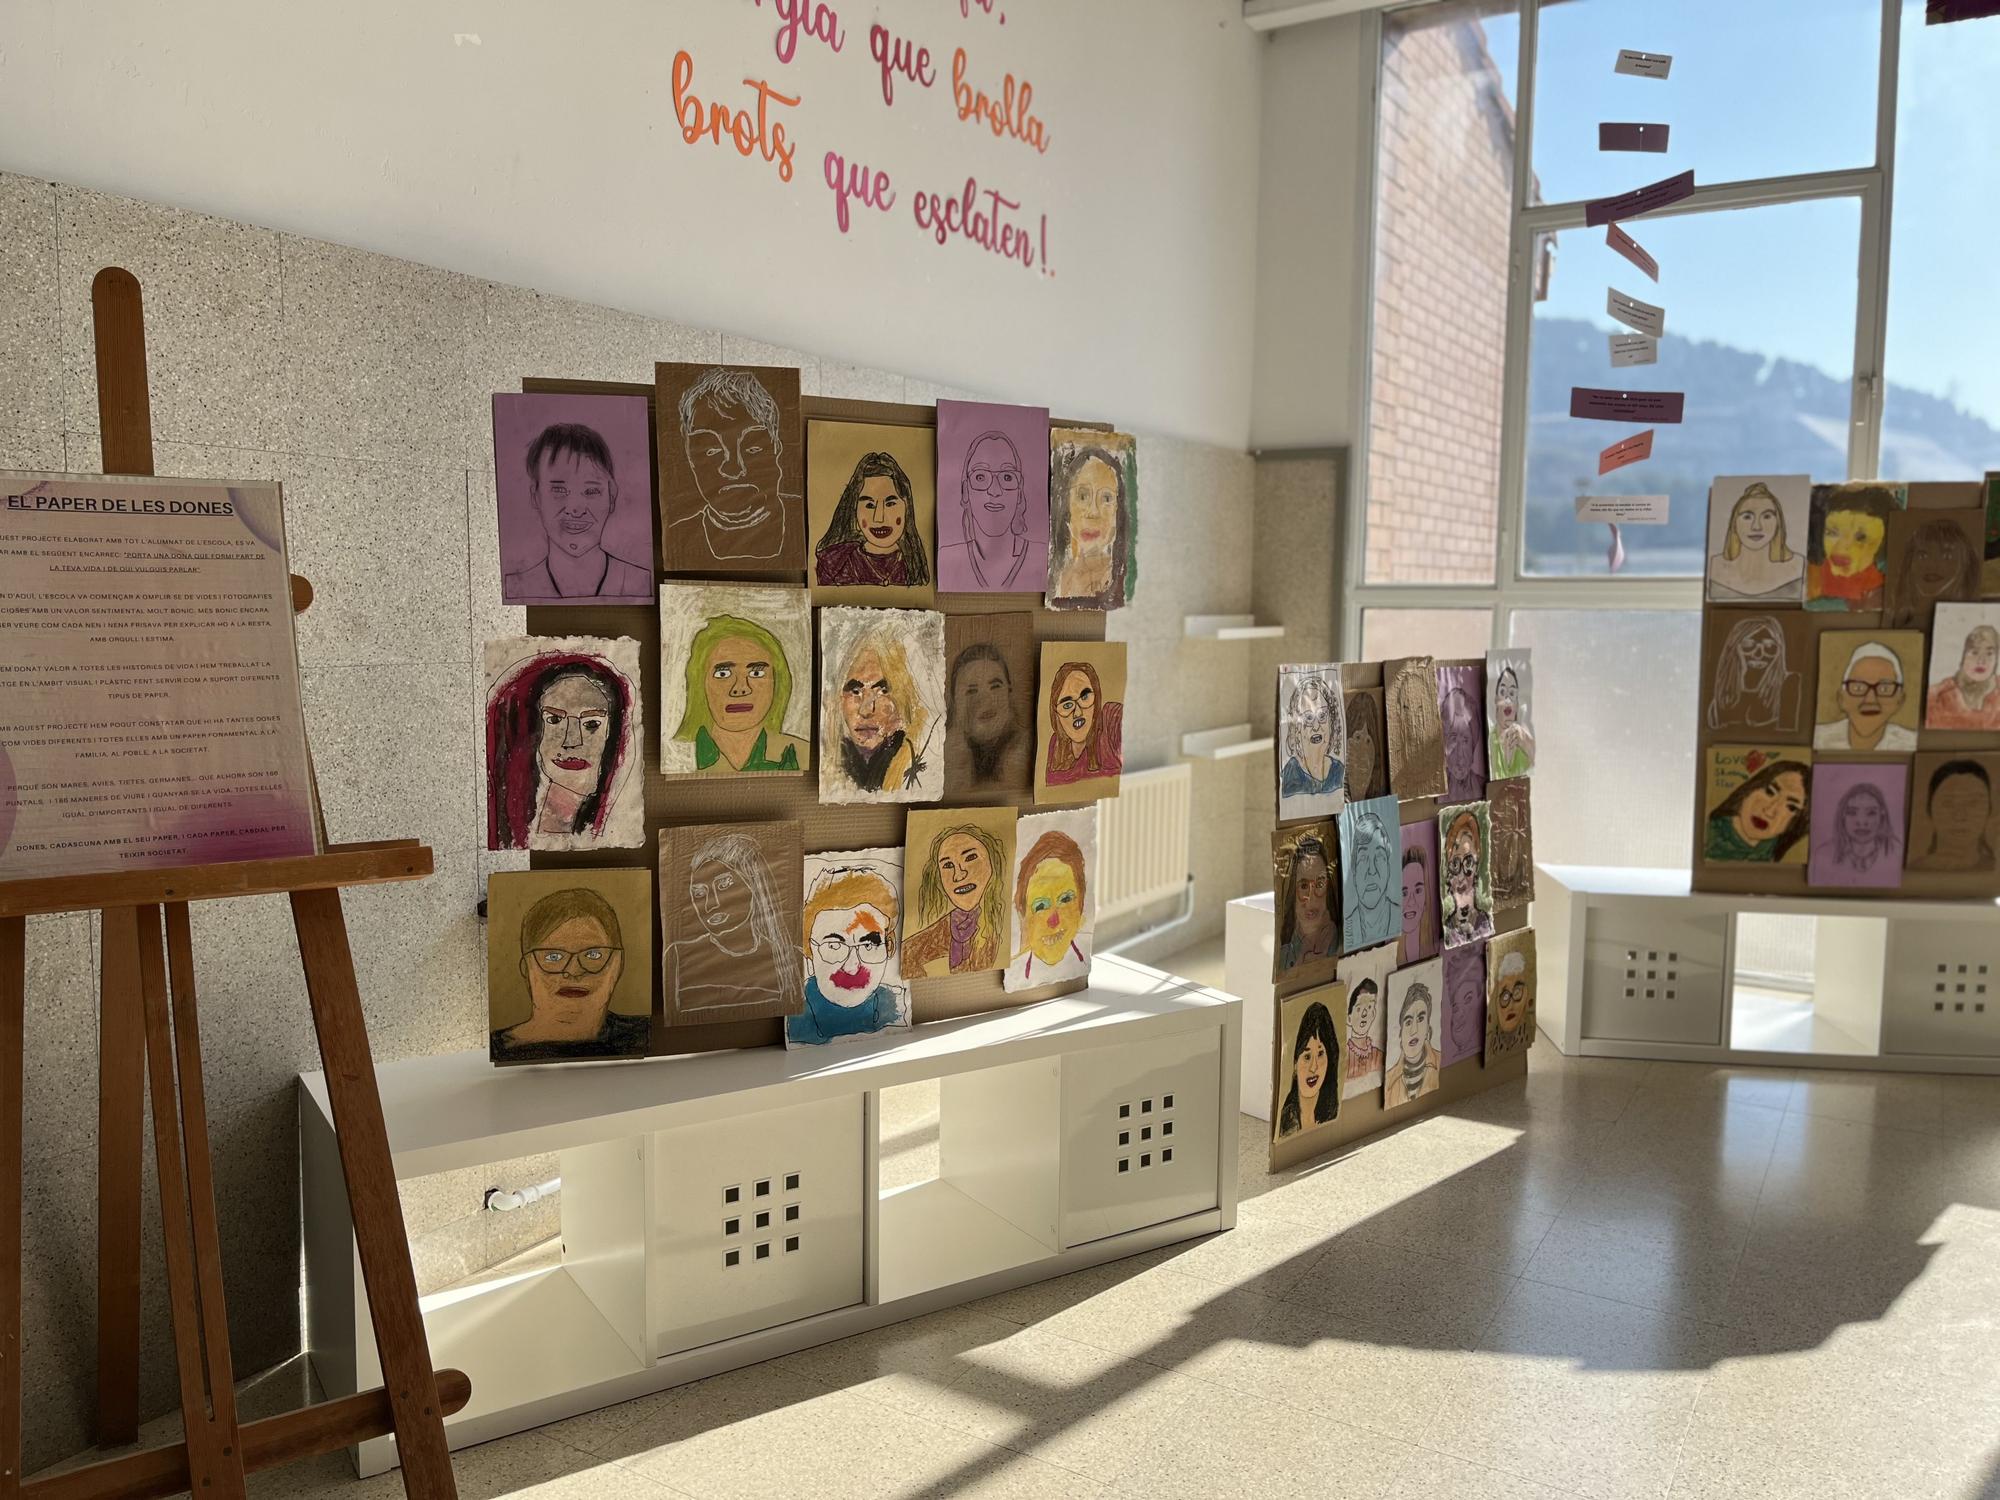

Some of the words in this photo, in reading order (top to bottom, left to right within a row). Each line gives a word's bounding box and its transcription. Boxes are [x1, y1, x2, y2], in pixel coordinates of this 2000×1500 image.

[869, 23, 937, 106] que
[951, 47, 1051, 154] brolla
[671, 50, 801, 182] brots
[823, 151, 896, 233] que
[7, 495, 31, 508] EL
[36, 496, 97, 511] PAPER
[102, 498, 127, 512] DE
[131, 499, 165, 513] LES
[169, 500, 233, 514] DONES
[208, 730, 258, 738] FONAMENTAL
[89, 807, 147, 816] D'IMPORTANTS
[50, 840, 102, 849] CADASCUNA
